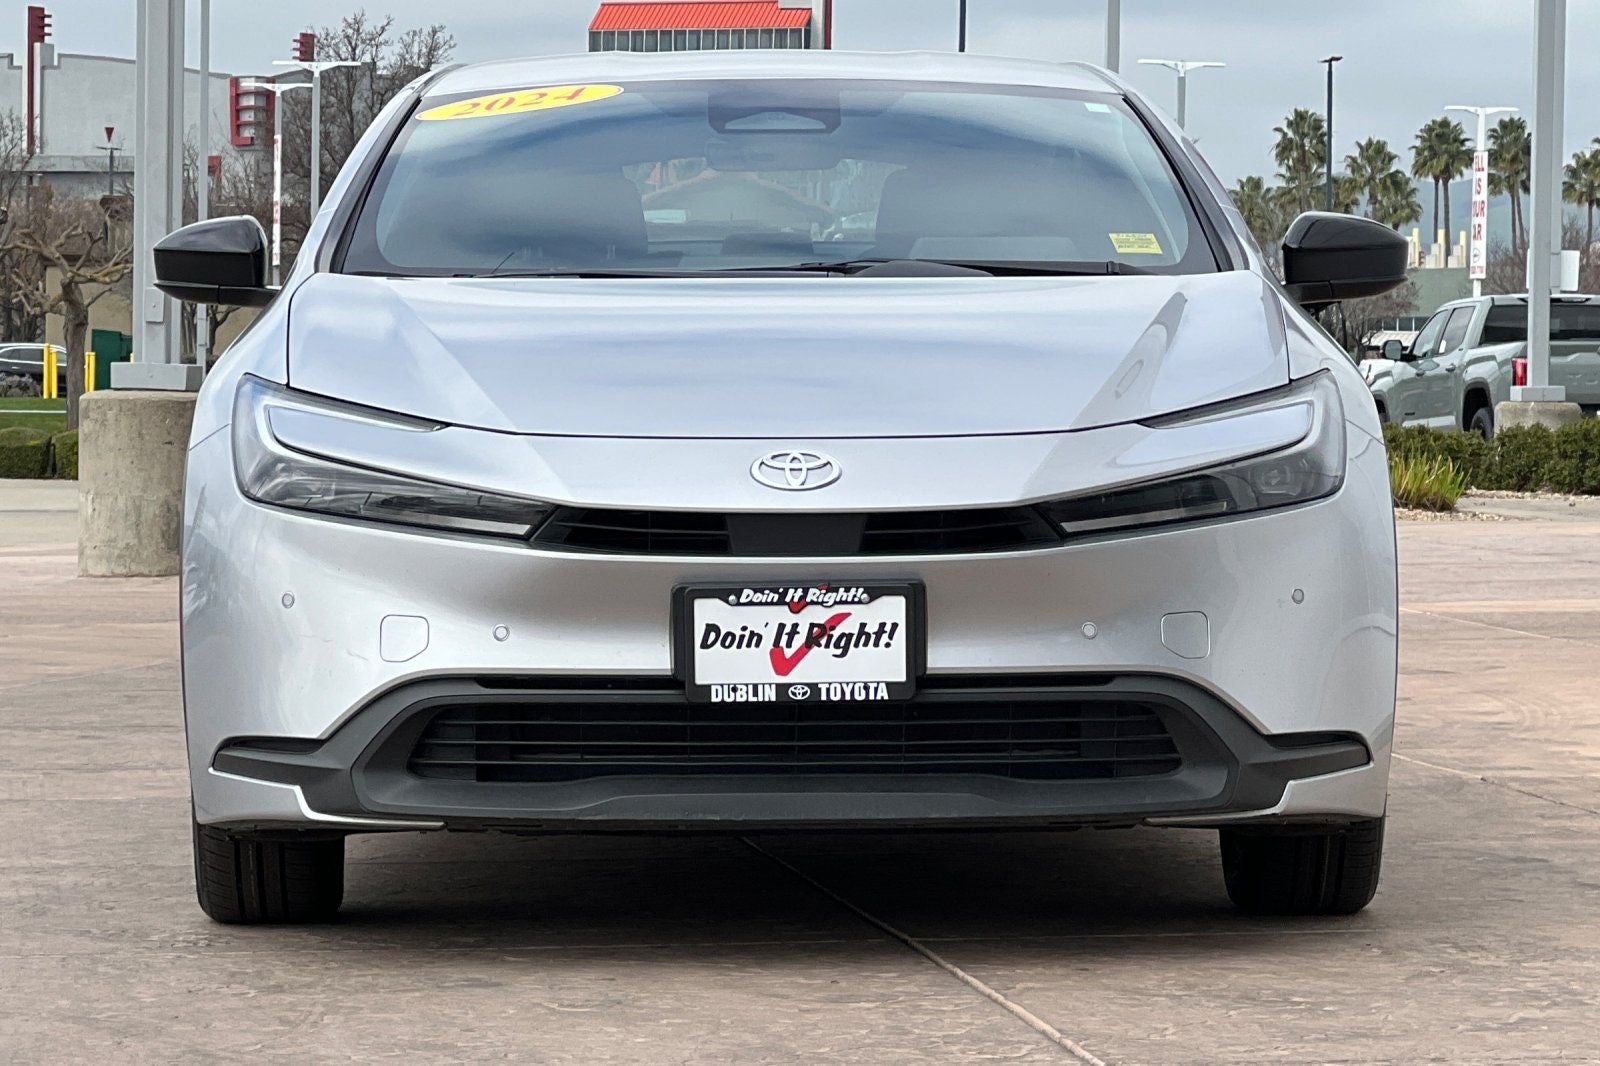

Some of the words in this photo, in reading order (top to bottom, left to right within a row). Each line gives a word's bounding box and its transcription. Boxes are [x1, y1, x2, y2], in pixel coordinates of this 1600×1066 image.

[453, 86, 586, 116] 2024
[739, 588, 783, 603] Doin'
[787, 588, 804, 602] It
[806, 588, 865, 606] Right!
[700, 622, 768, 649] Doin'
[772, 622, 800, 648] It
[804, 622, 899, 658] Right!
[711, 683, 776, 702] DUBLIN
[818, 682, 889, 700] TOYOTA
